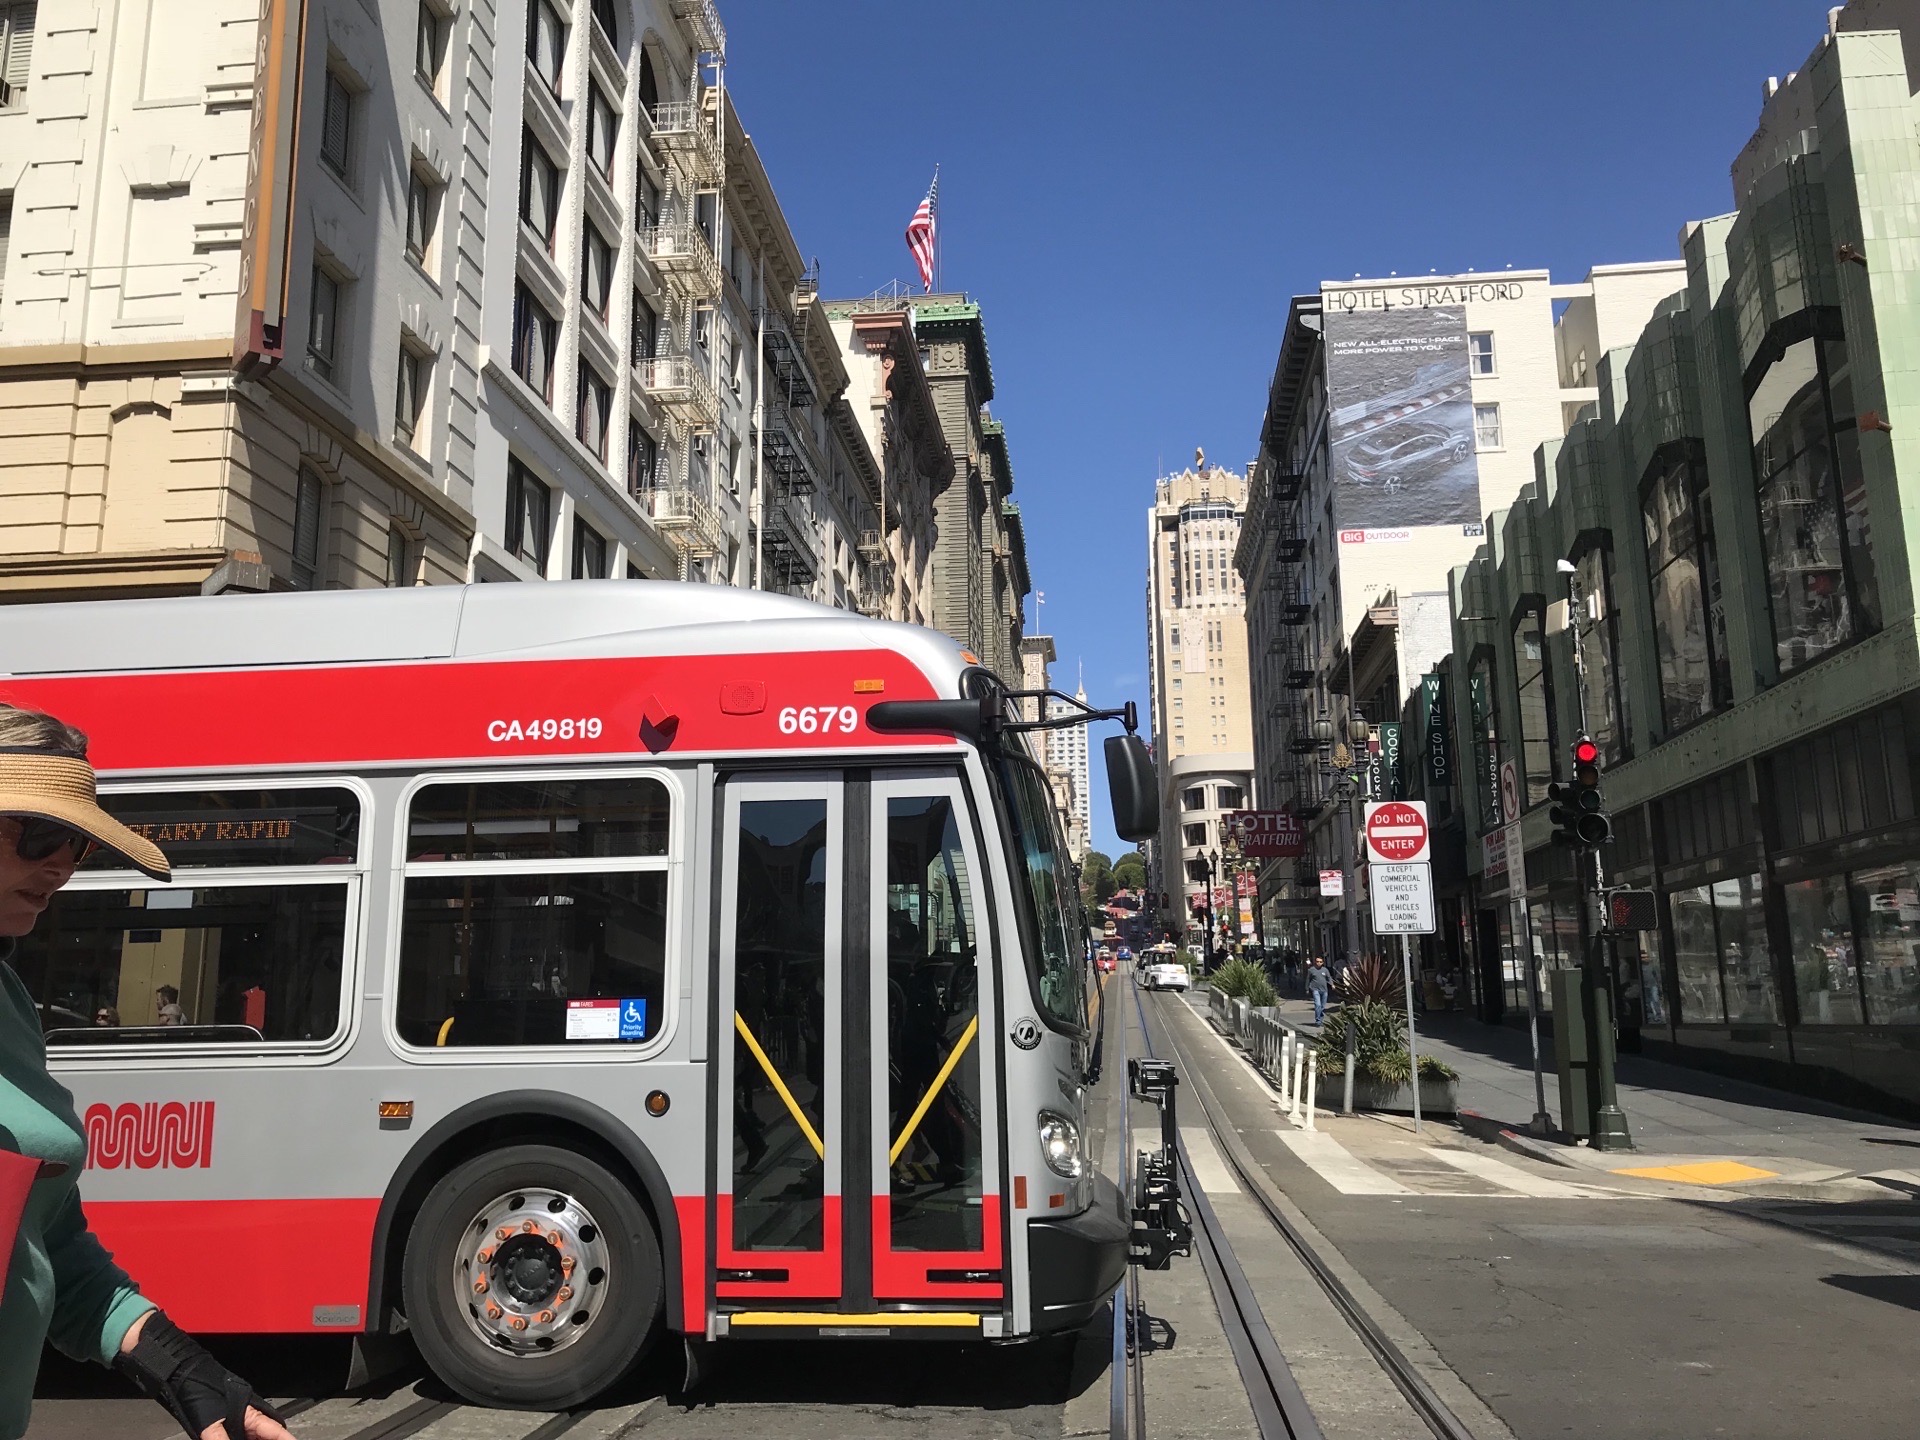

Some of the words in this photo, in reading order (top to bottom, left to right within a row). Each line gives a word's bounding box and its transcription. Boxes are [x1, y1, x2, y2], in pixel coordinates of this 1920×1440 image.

[1328, 289, 1395, 309] HOTEL
[1402, 283, 1524, 306] STRATFORD
[1359, 338, 1427, 347] ALL-ELECTRIC
[1365, 346, 1402, 354] POWER
[1343, 532, 1363, 542] BIG
[1366, 531, 1410, 540] OUTDOOR
[1427, 680, 1441, 726] WINE
[778, 706, 859, 735] 6679
[487, 717, 603, 742] CA49819
[1432, 732, 1446, 779] SHOP
[1226, 814, 1299, 831] HOTEL
[1375, 814, 1390, 824] DO
[1396, 813, 1417, 823] NOT
[216, 820, 291, 840] RAPID
[1381, 839, 1415, 850] ENTER
[1385, 884, 1418, 892] VEHICLES
[1386, 903, 1420, 911] VEHICLES
[1390, 913, 1417, 921] LOADING
[1398, 922, 1424, 930] POWELL
